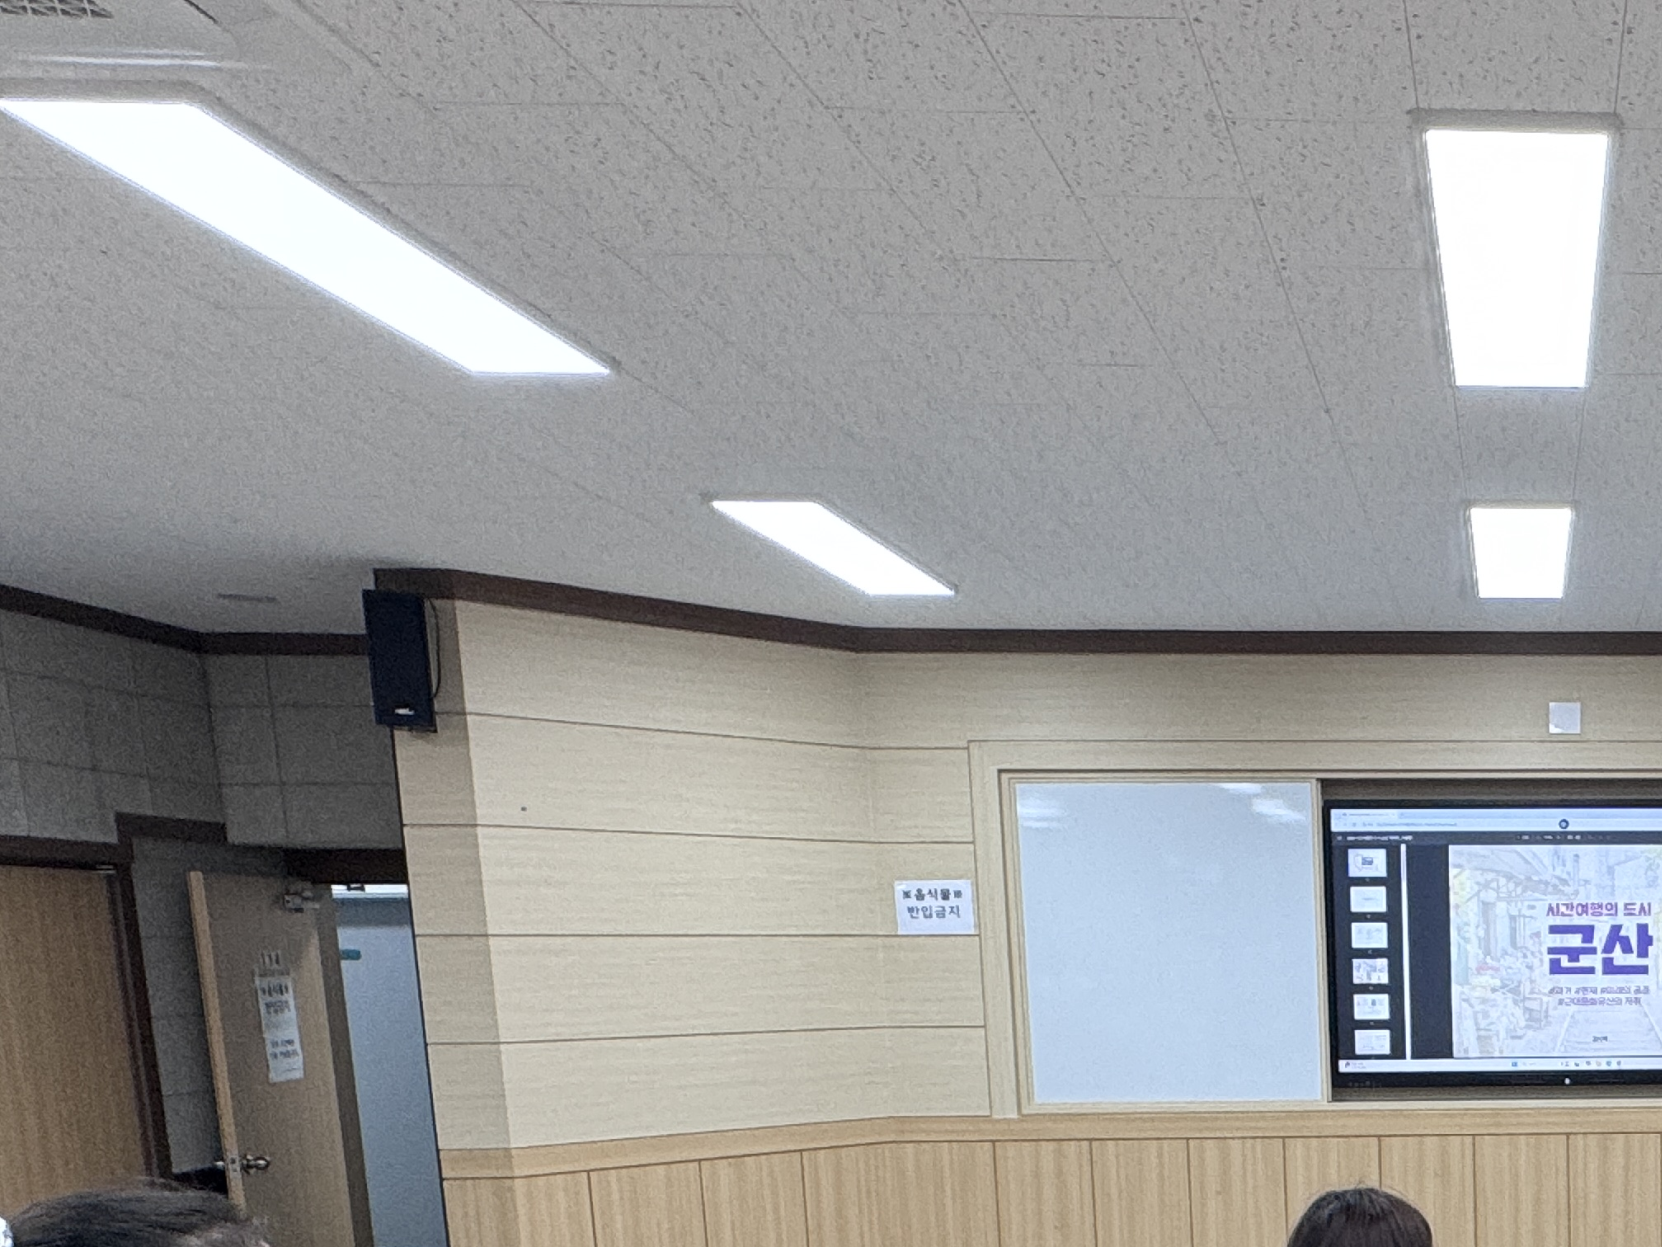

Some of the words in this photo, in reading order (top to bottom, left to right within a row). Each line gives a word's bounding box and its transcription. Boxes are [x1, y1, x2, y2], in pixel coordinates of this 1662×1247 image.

[907, 904, 961, 919] 반입금지
[1546, 902, 1618, 917] 시간여행의
[1623, 902, 1652, 917] 도시
[1547, 922, 1653, 975] 군산
